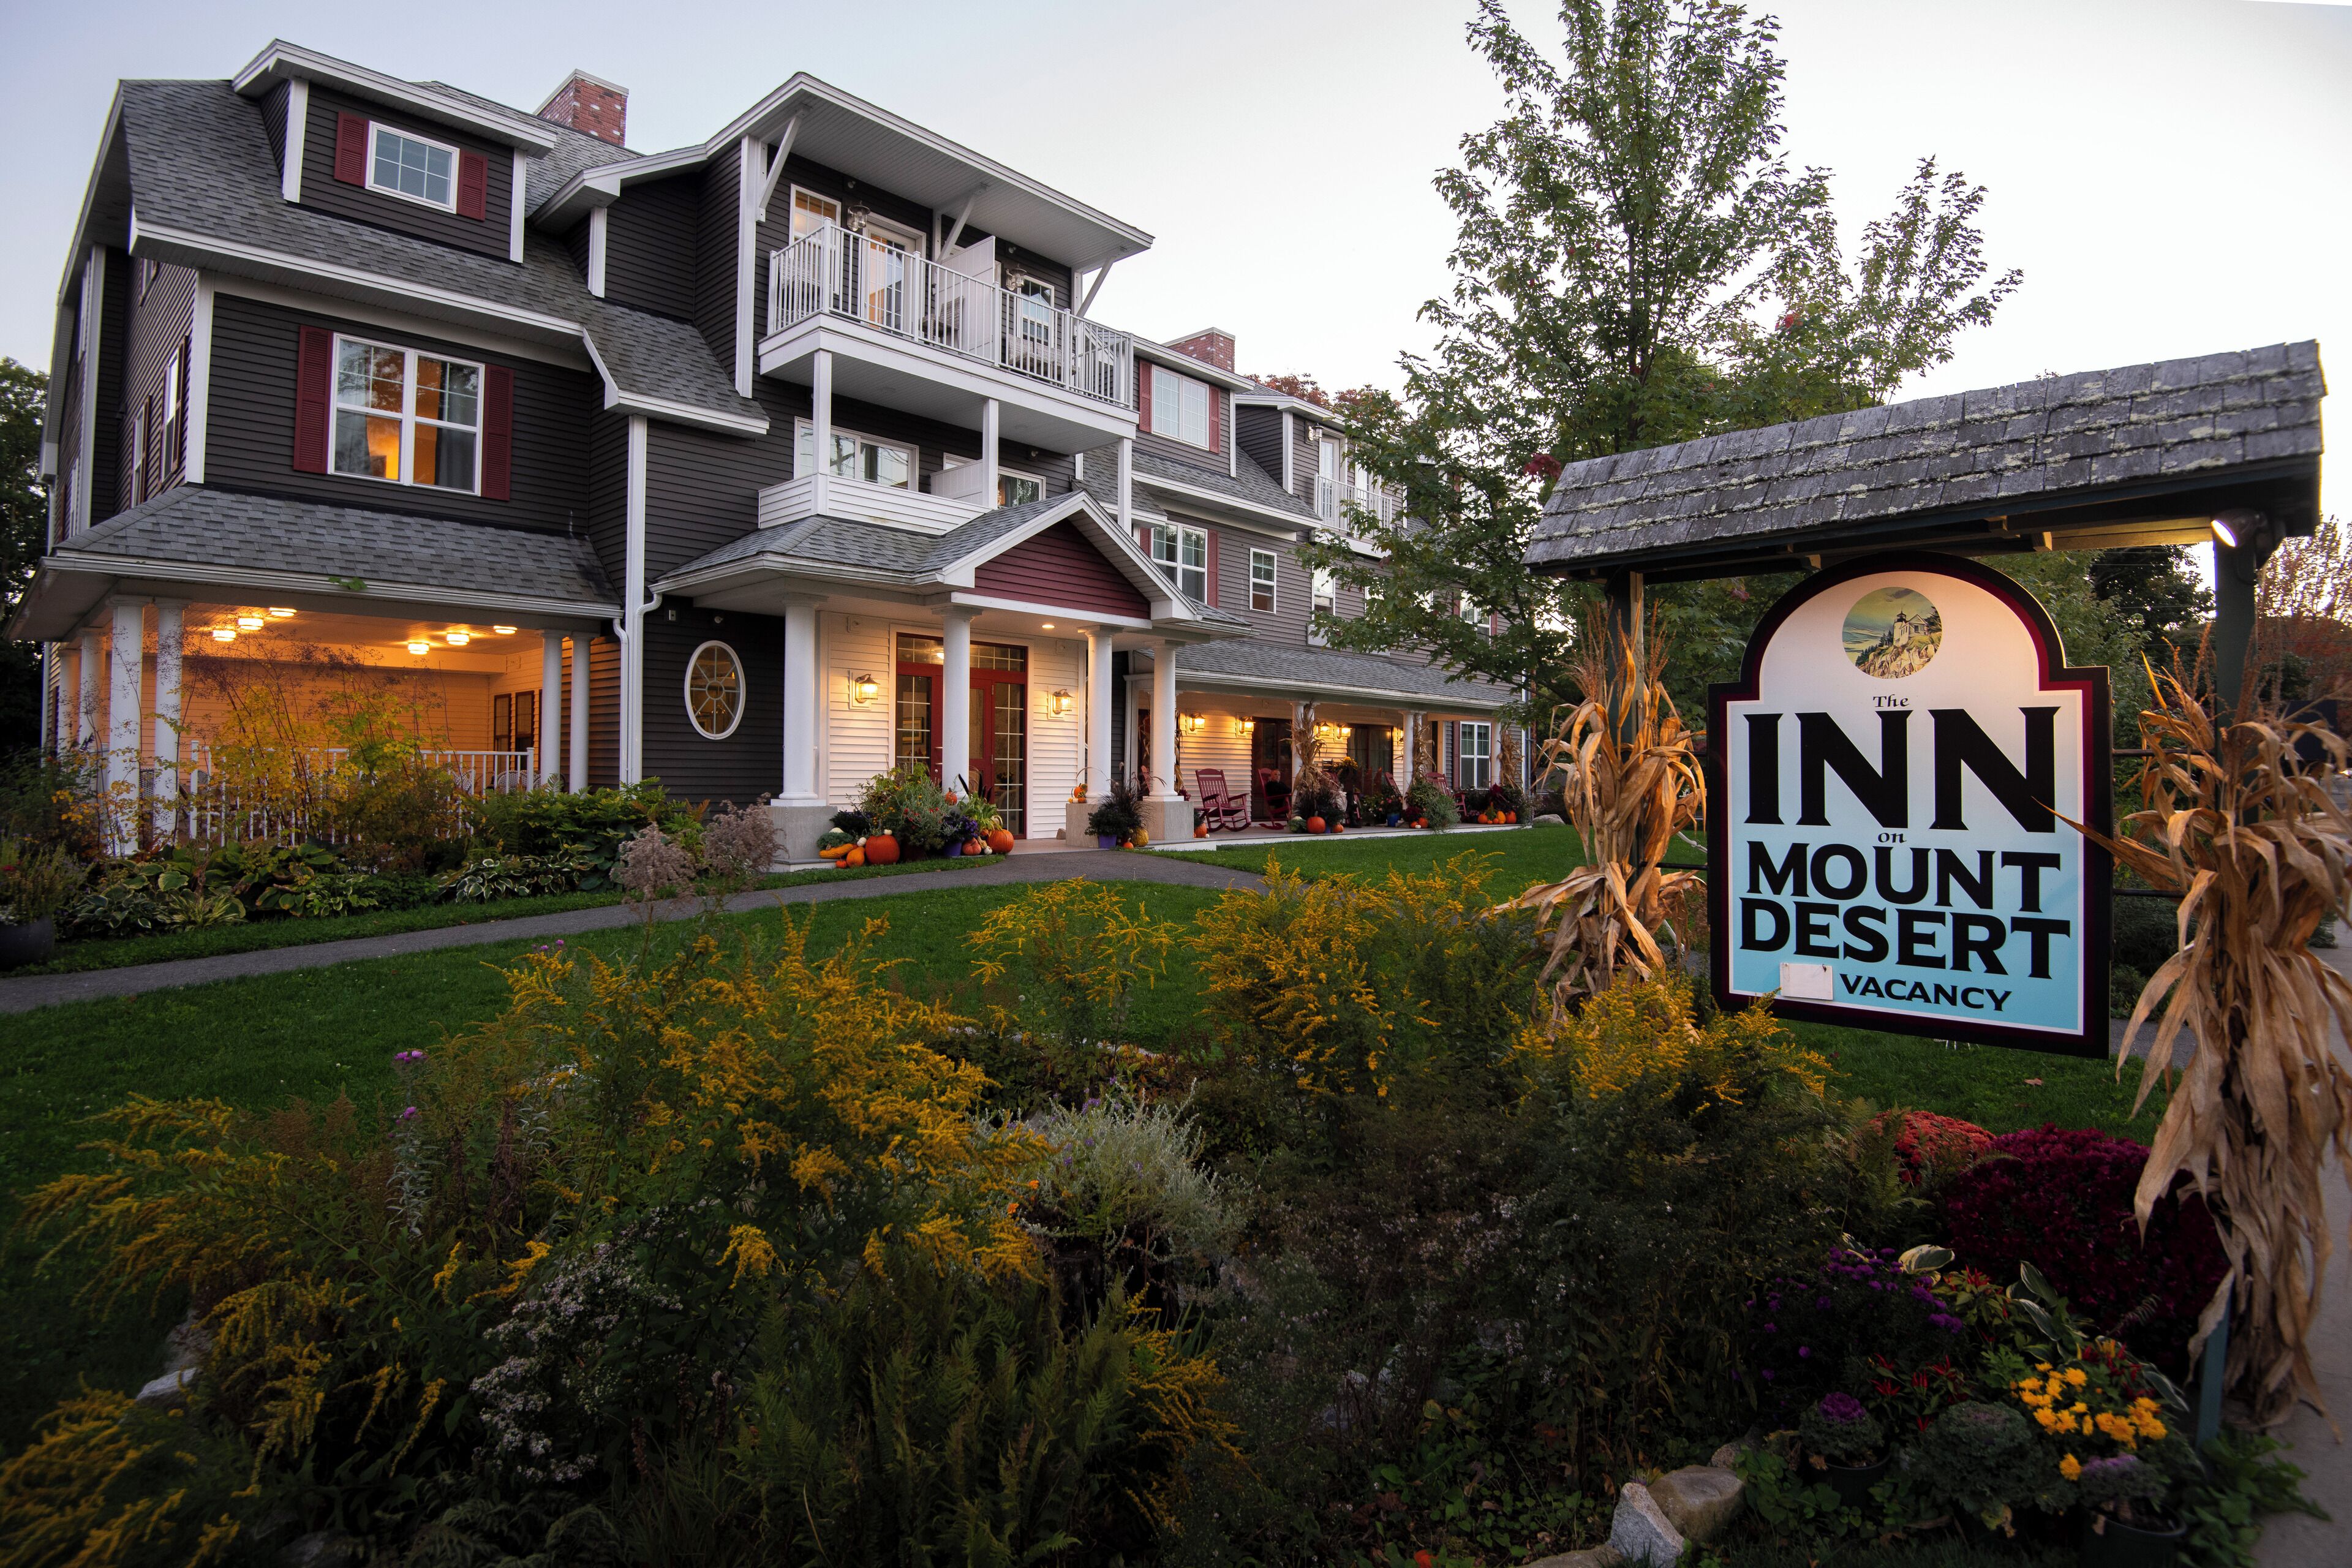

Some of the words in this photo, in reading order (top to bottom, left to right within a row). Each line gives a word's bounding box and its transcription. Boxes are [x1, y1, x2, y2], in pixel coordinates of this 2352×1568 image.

[1873, 694, 1910, 708] The
[1743, 706, 2061, 833] INN
[1877, 831, 1907, 844] on
[1747, 841, 2060, 913] MOUNT
[1740, 897, 2070, 979] DESERT
[1839, 973, 2012, 1012] VACANCY
